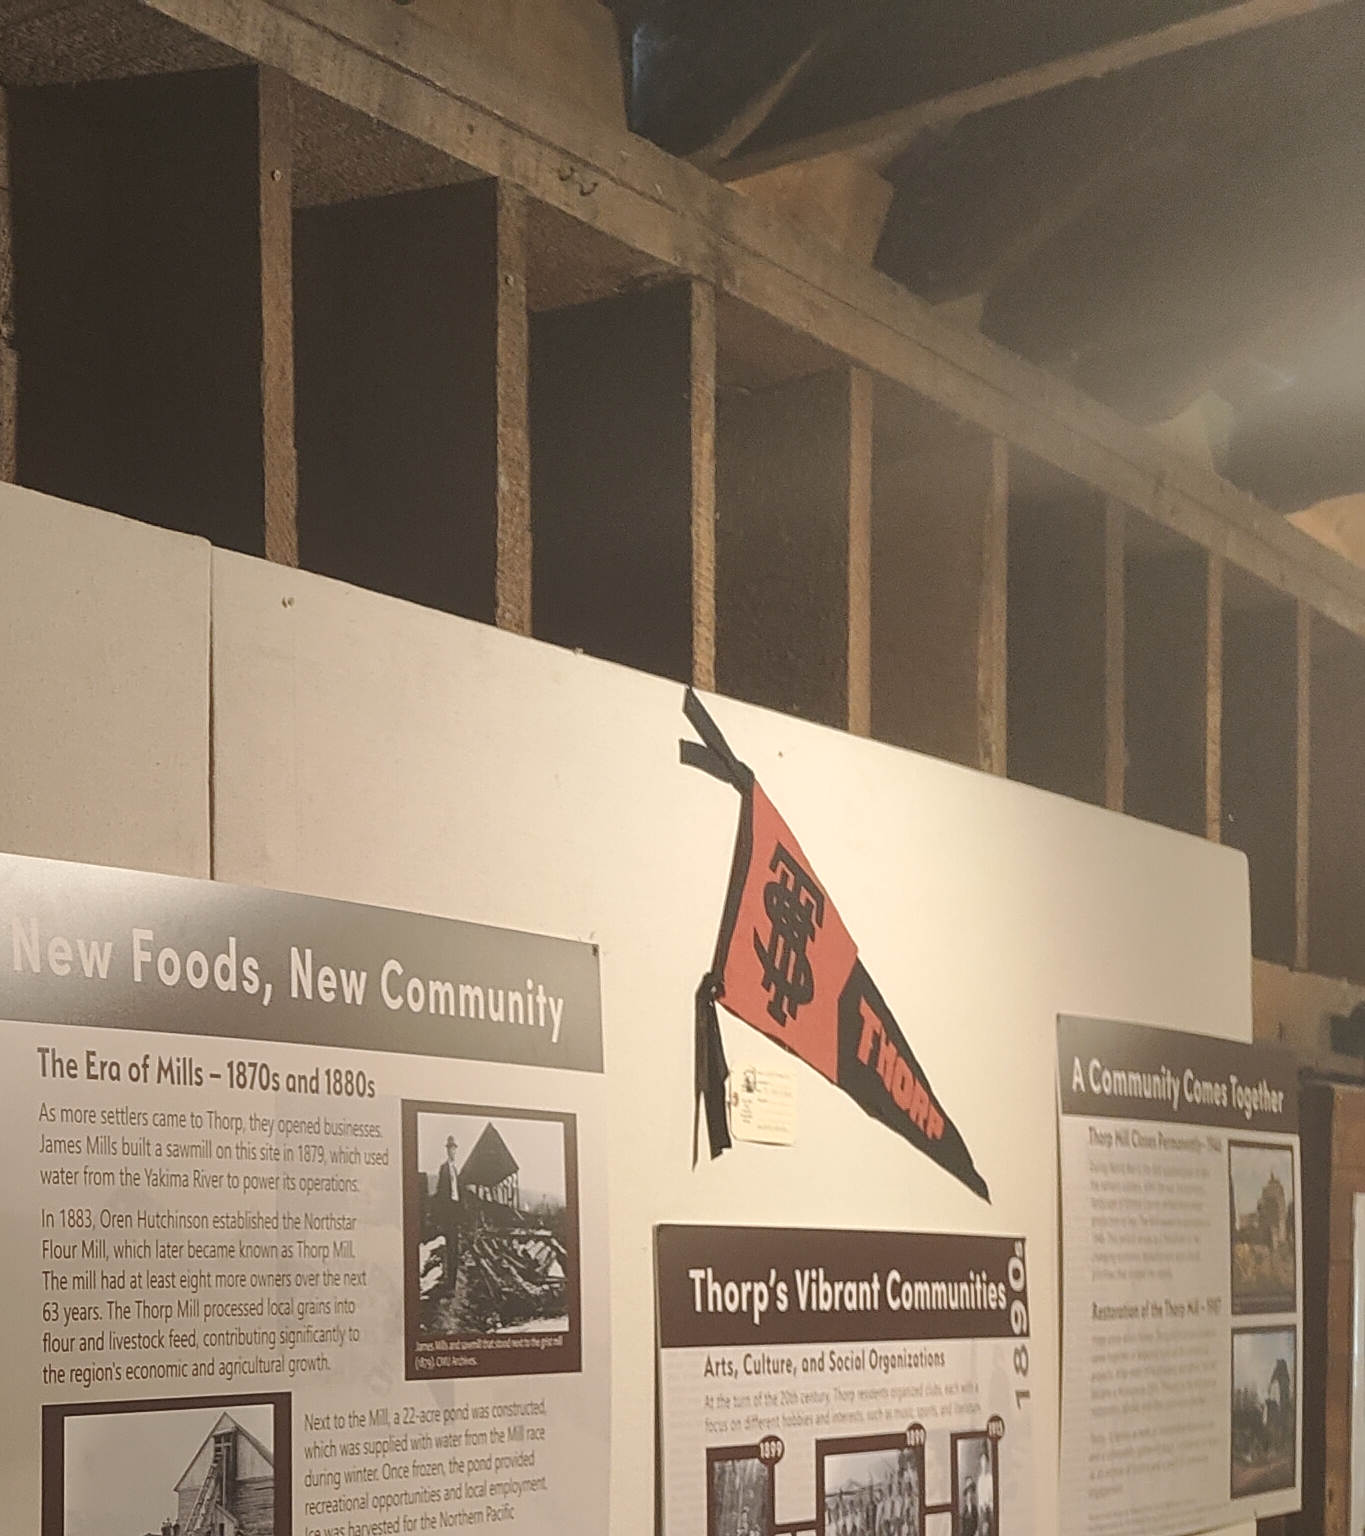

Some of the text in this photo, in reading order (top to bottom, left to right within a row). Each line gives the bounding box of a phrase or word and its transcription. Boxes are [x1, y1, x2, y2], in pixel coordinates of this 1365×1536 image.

[11, 916, 565, 1044] New Foods, New Community
[35, 1045, 78, 1079] The
[84, 1048, 121, 1082] Era
[126, 1052, 150, 1084] of
[155, 1054, 204, 1087] Mills
[225, 1059, 280, 1092] 1870s
[284, 1066, 320, 1095] and
[323, 1067, 376, 1099] 1880s
[856, 995, 946, 1140] THORP
[1071, 1055, 1284, 1120] A Community Comes Together
[37, 1100, 56, 1123] As
[59, 1107, 97, 1125] more
[99, 1104, 149, 1127] settlers
[151, 1111, 187, 1129] came
[188, 1110, 204, 1129] to
[247, 1111, 275, 1138] they
[276, 1115, 321, 1139] opened
[40, 1207, 358, 1231] In 1883, Oren Hutchinson established the Northstar
[687, 1266, 1007, 1325] Thorp's Vibrant Communities
[702, 1346, 946, 1380] Arts, Culture, and Social Organizations
